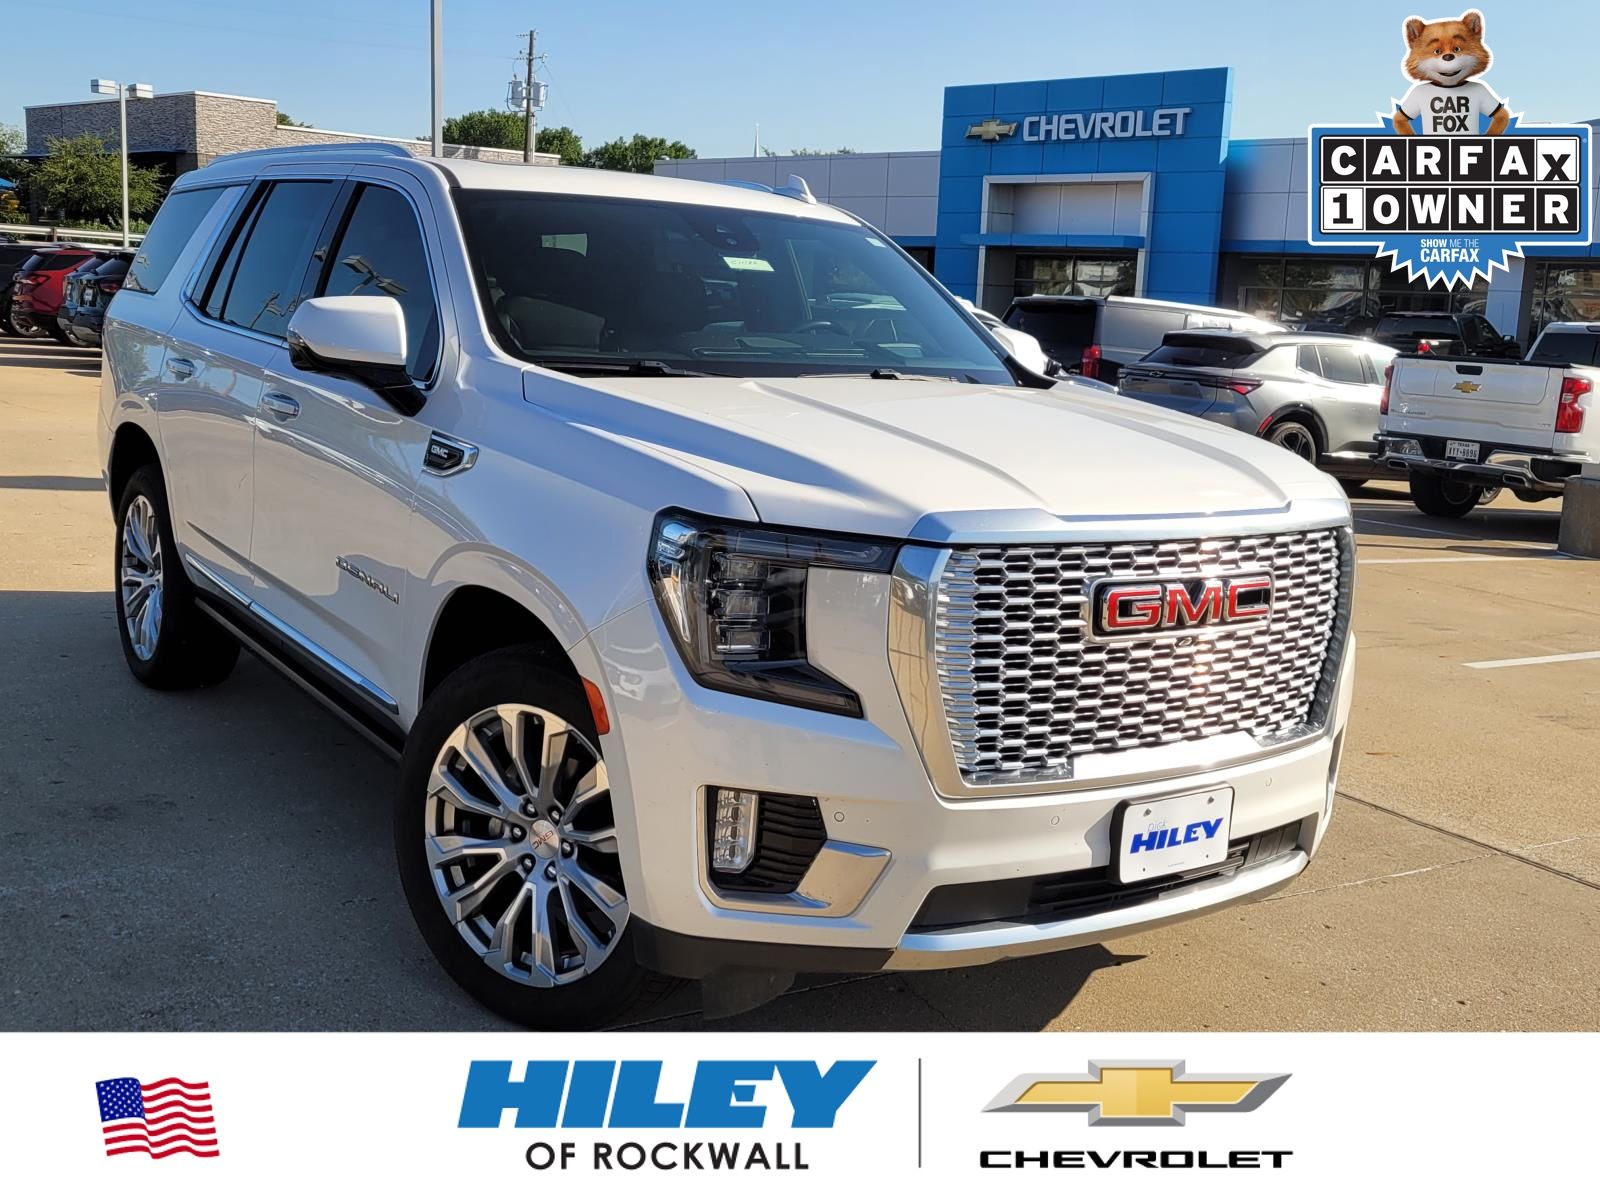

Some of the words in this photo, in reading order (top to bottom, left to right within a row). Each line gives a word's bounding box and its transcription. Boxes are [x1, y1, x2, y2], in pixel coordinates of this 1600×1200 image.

[1022, 107, 1192, 142] CHEVROLET
[431, 444, 449, 459] GMC
[335, 555, 400, 605] DENALI
[1102, 576, 1271, 632] GMC
[531, 829, 554, 850] GMC
[1129, 817, 1224, 855] HILEY
